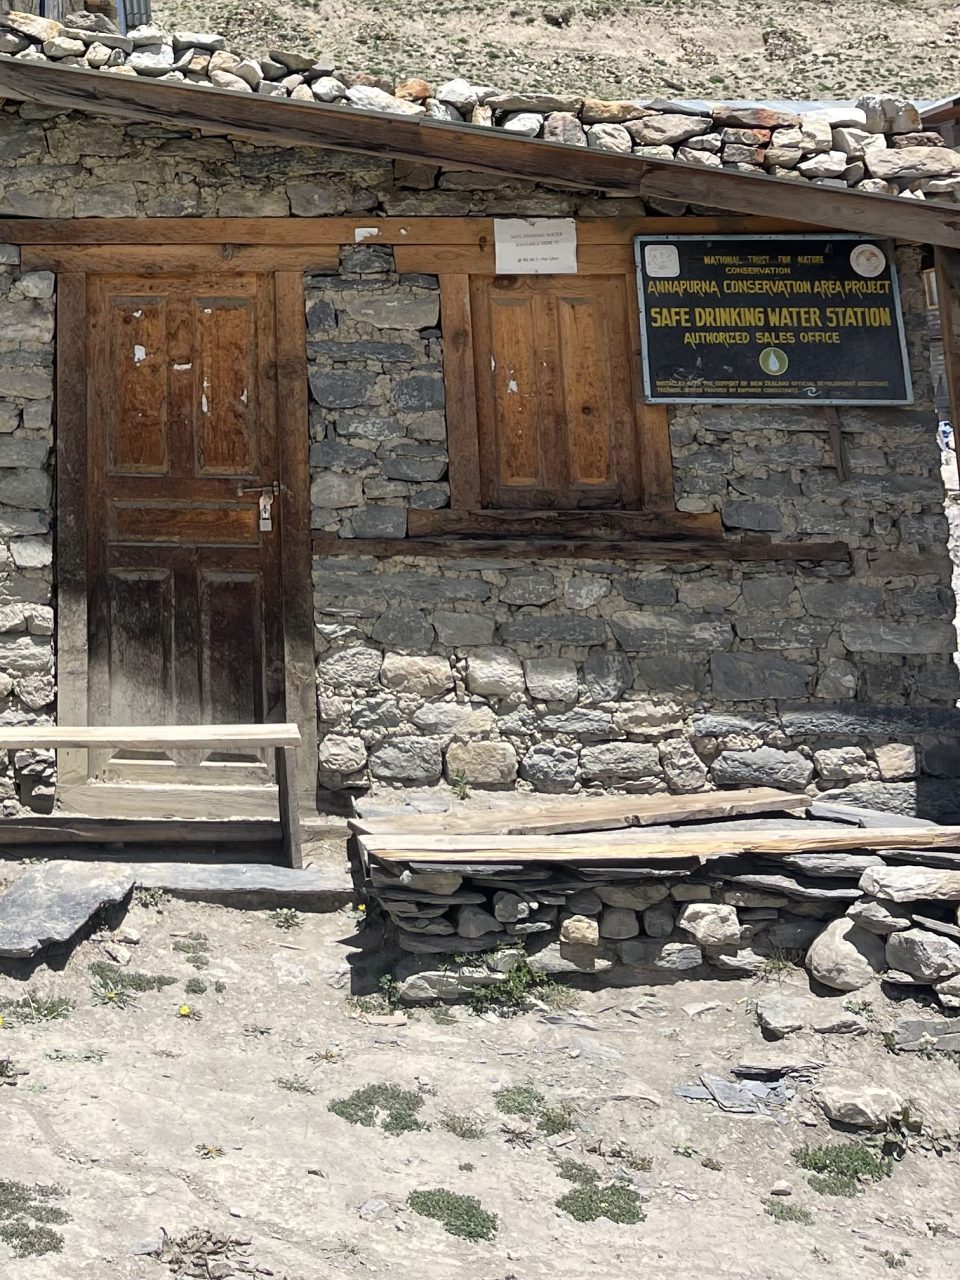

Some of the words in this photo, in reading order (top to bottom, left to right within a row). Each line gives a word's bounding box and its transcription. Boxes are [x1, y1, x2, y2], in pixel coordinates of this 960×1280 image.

[703, 255, 740, 265] NATIONAL
[747, 255, 770, 265] TRUST
[777, 255, 792, 265] FOR
[797, 255, 825, 265] NATURE
[725, 266, 792, 275] CONSERVATION
[647, 280, 721, 298] ANNAPURNA
[723, 280, 813, 299] CONSERVATION
[813, 280, 846, 299] AREA
[844, 280, 891, 300] PROJECT
[650, 307, 692, 327] SAFE
[695, 307, 765, 327] DRINKING
[767, 307, 823, 327] WATER
[826, 307, 892, 327] STATION
[683, 332, 750, 348] AUTHORIZED
[755, 332, 796, 345] SALES
[799, 332, 841, 344] OFFICE
